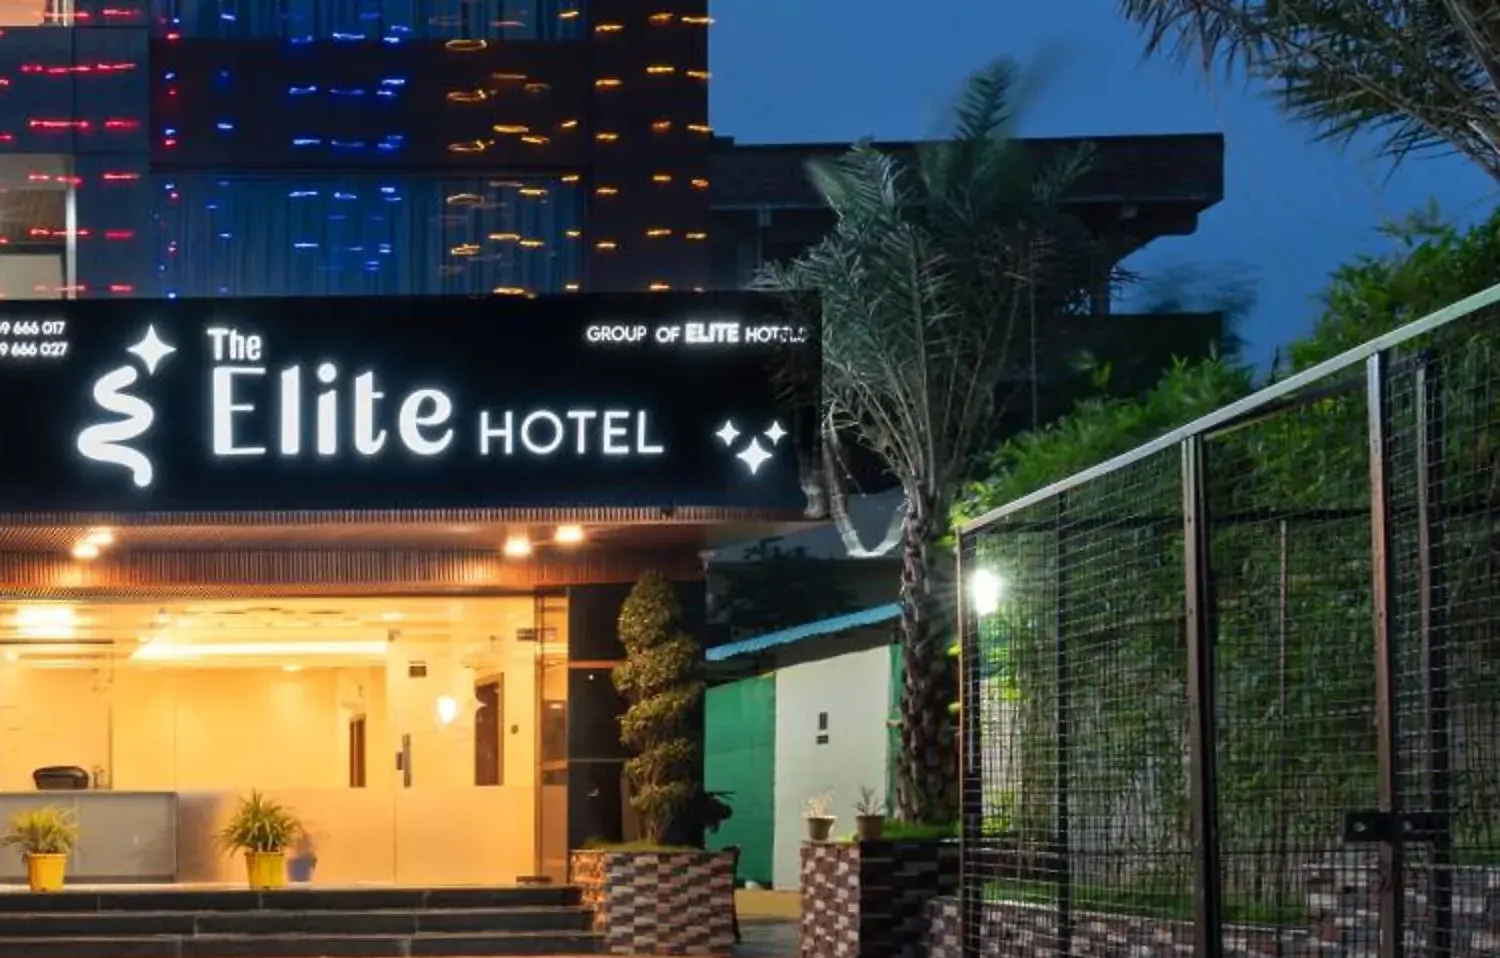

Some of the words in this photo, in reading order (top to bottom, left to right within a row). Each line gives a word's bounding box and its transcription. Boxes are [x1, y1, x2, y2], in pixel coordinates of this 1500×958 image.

[12, 320, 40, 335] 666
[41, 320, 67, 335] 017
[586, 325, 647, 343] GROUP
[655, 326, 681, 344] OF
[684, 322, 740, 343] ELITE
[10, 341, 38, 357] 666
[39, 341, 68, 357] 027
[207, 328, 262, 361] The
[213, 363, 454, 455] Elite
[480, 410, 665, 455] HOTEL
